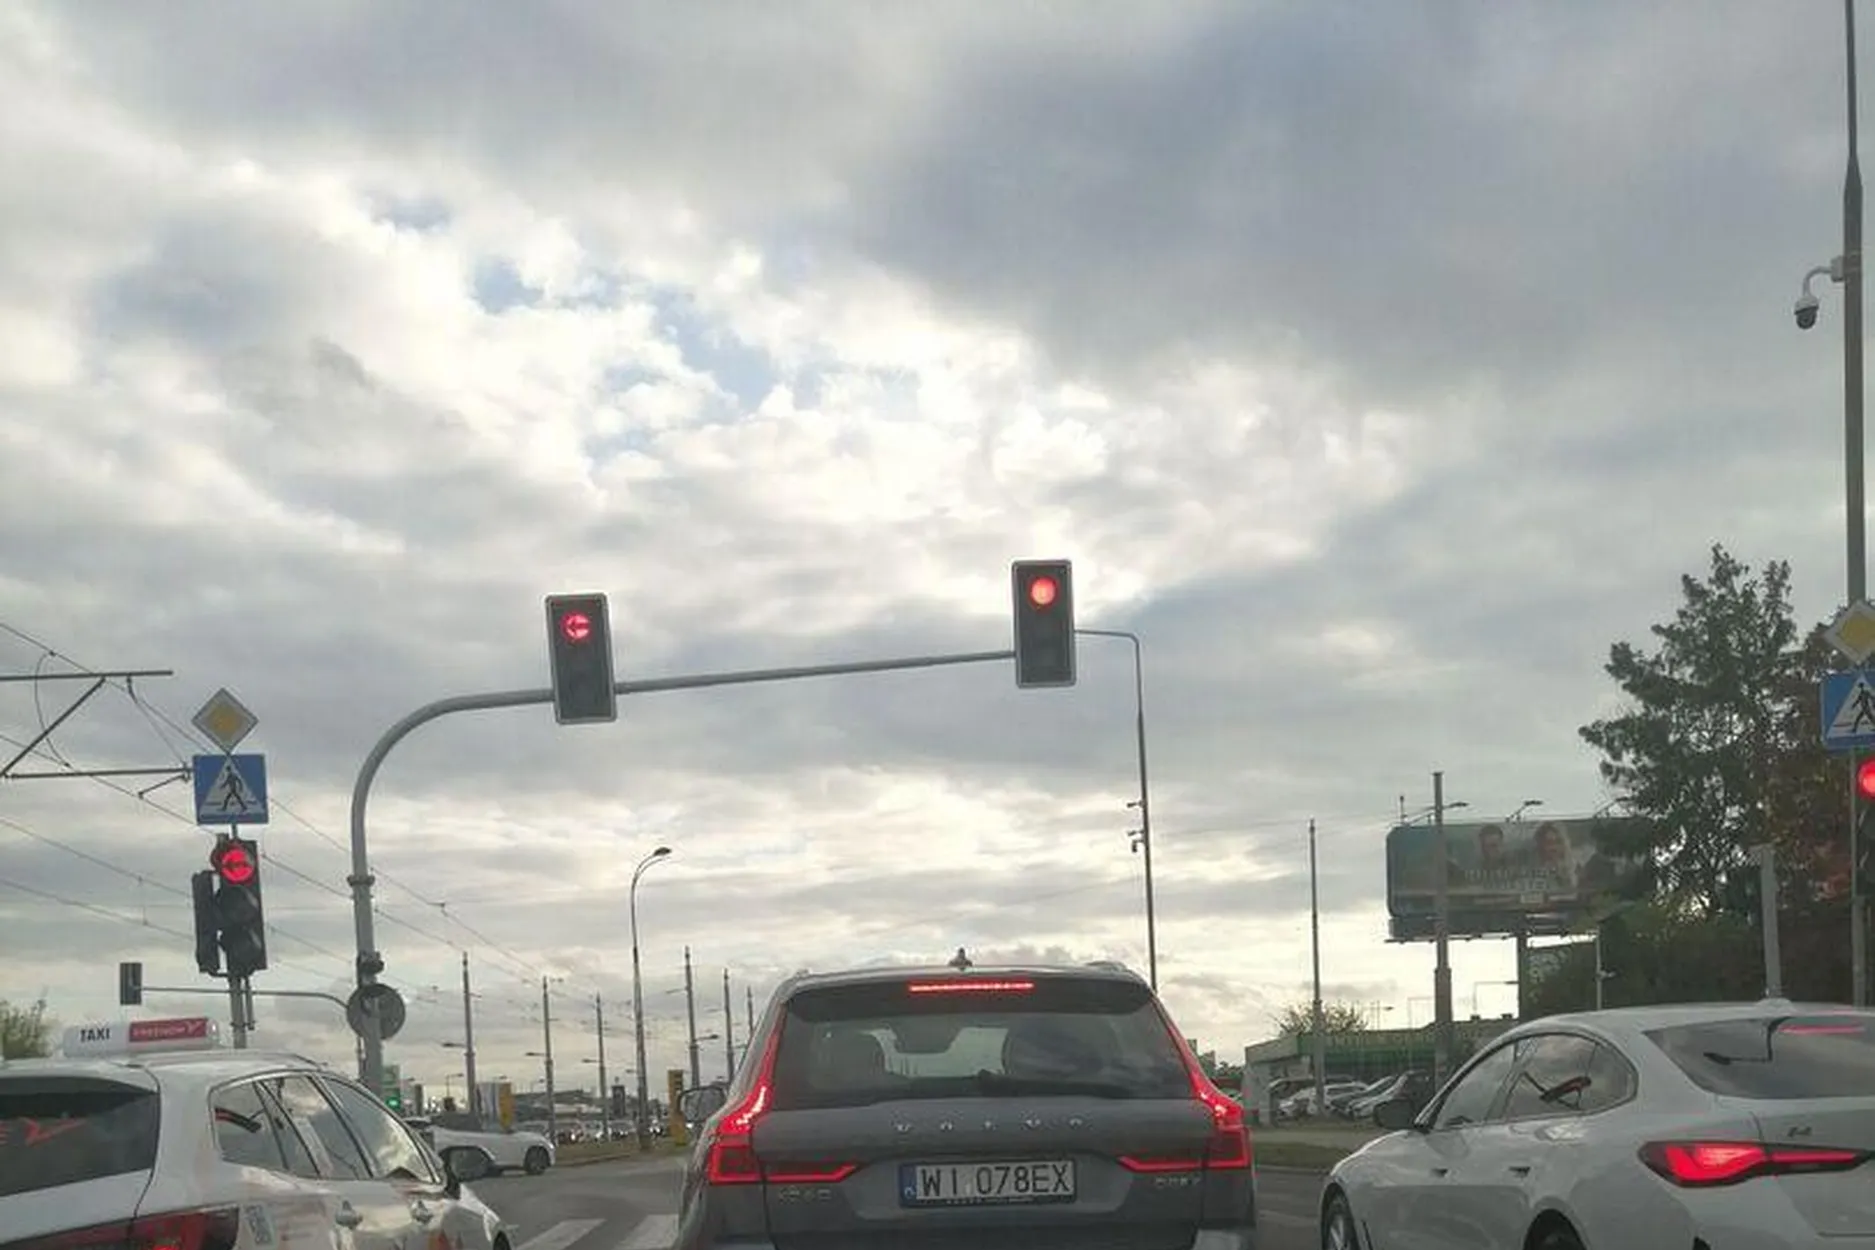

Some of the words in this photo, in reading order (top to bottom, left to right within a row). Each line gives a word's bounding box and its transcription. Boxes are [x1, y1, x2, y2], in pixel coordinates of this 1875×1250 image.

[79, 1027, 111, 1043] TAXI
[919, 1167, 958, 1198] WI
[975, 1163, 1070, 1196] 078EX
